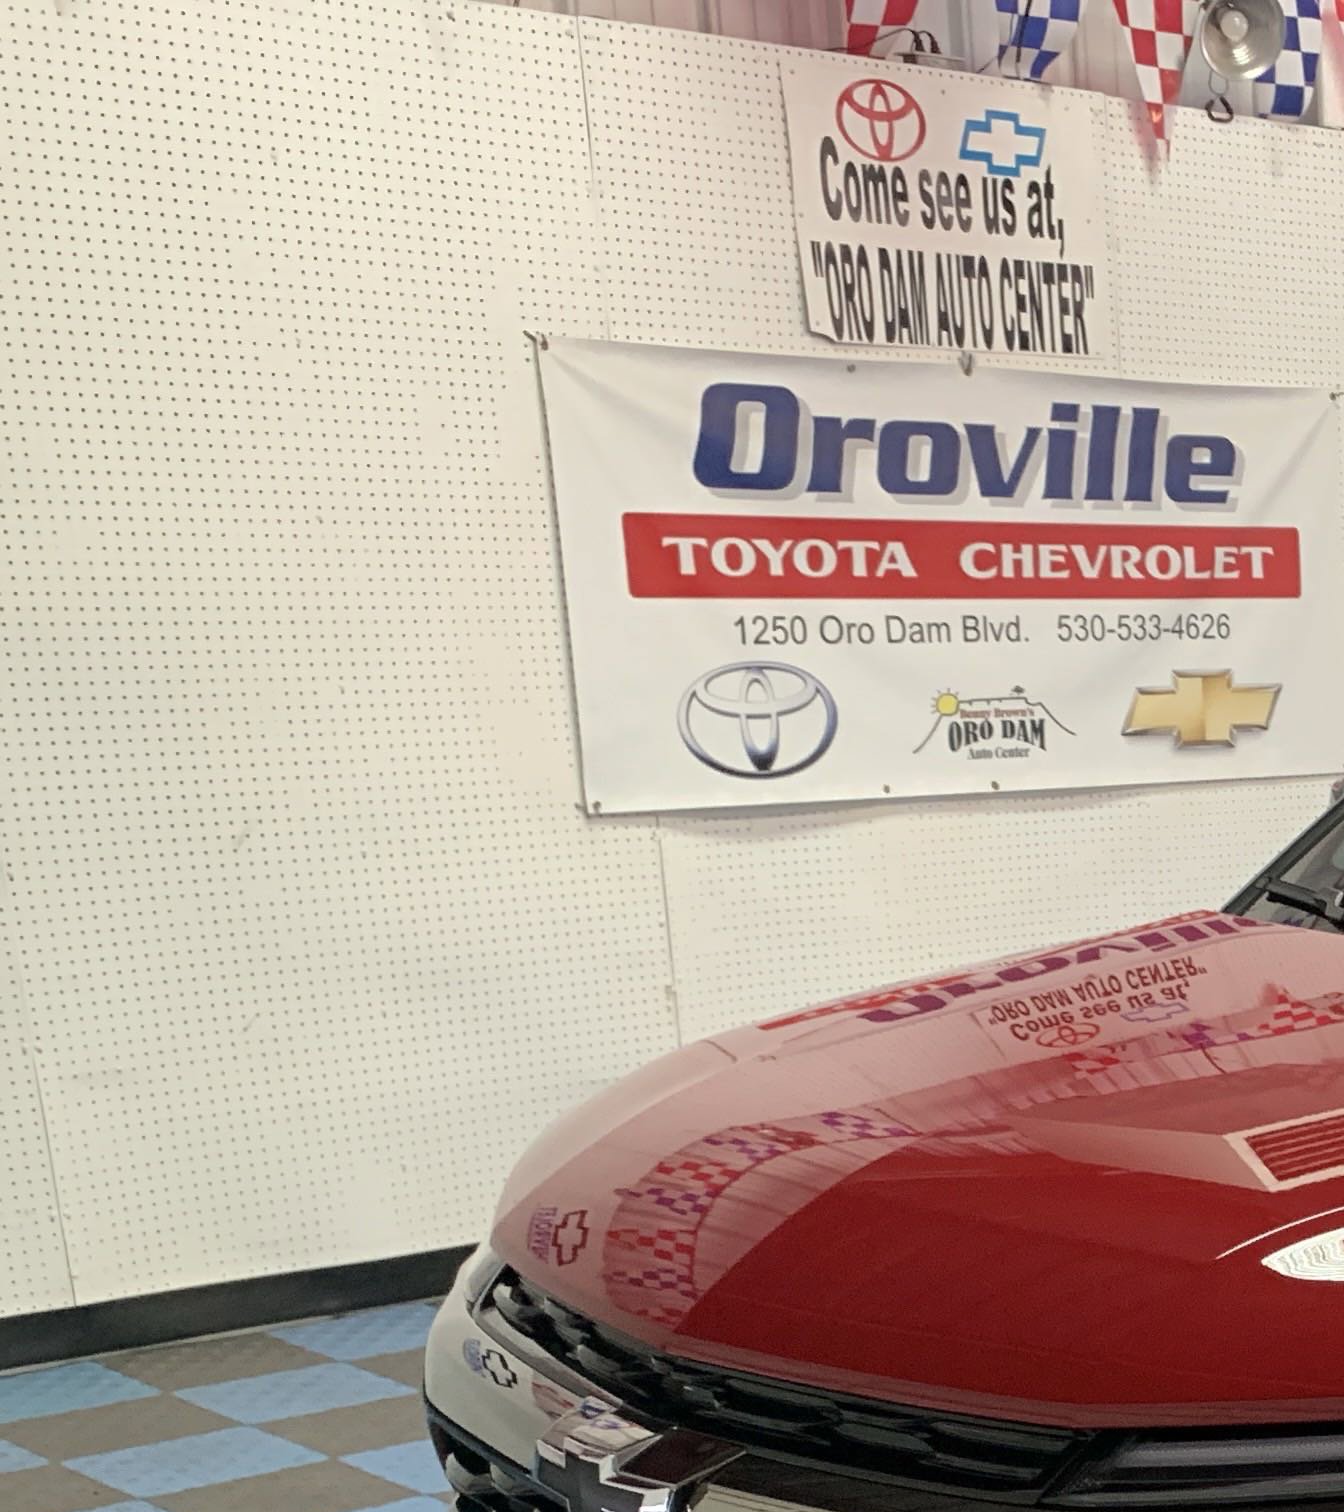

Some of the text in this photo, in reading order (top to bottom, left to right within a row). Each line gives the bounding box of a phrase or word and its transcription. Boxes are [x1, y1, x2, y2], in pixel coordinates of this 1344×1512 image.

[820, 136, 1064, 259] Come see us at,
[810, 241, 1094, 354] "ORO DAM AUTO CENTER"
[691, 382, 1238, 505] Oroville
[662, 535, 1274, 581] TOYOTA CHEVROLET
[733, 613, 1231, 645] 1250 Oro Dam Blvd. 530-533-4626
[948, 718, 1047, 752] ORO DAM
[967, 747, 1030, 760] Auto Center
